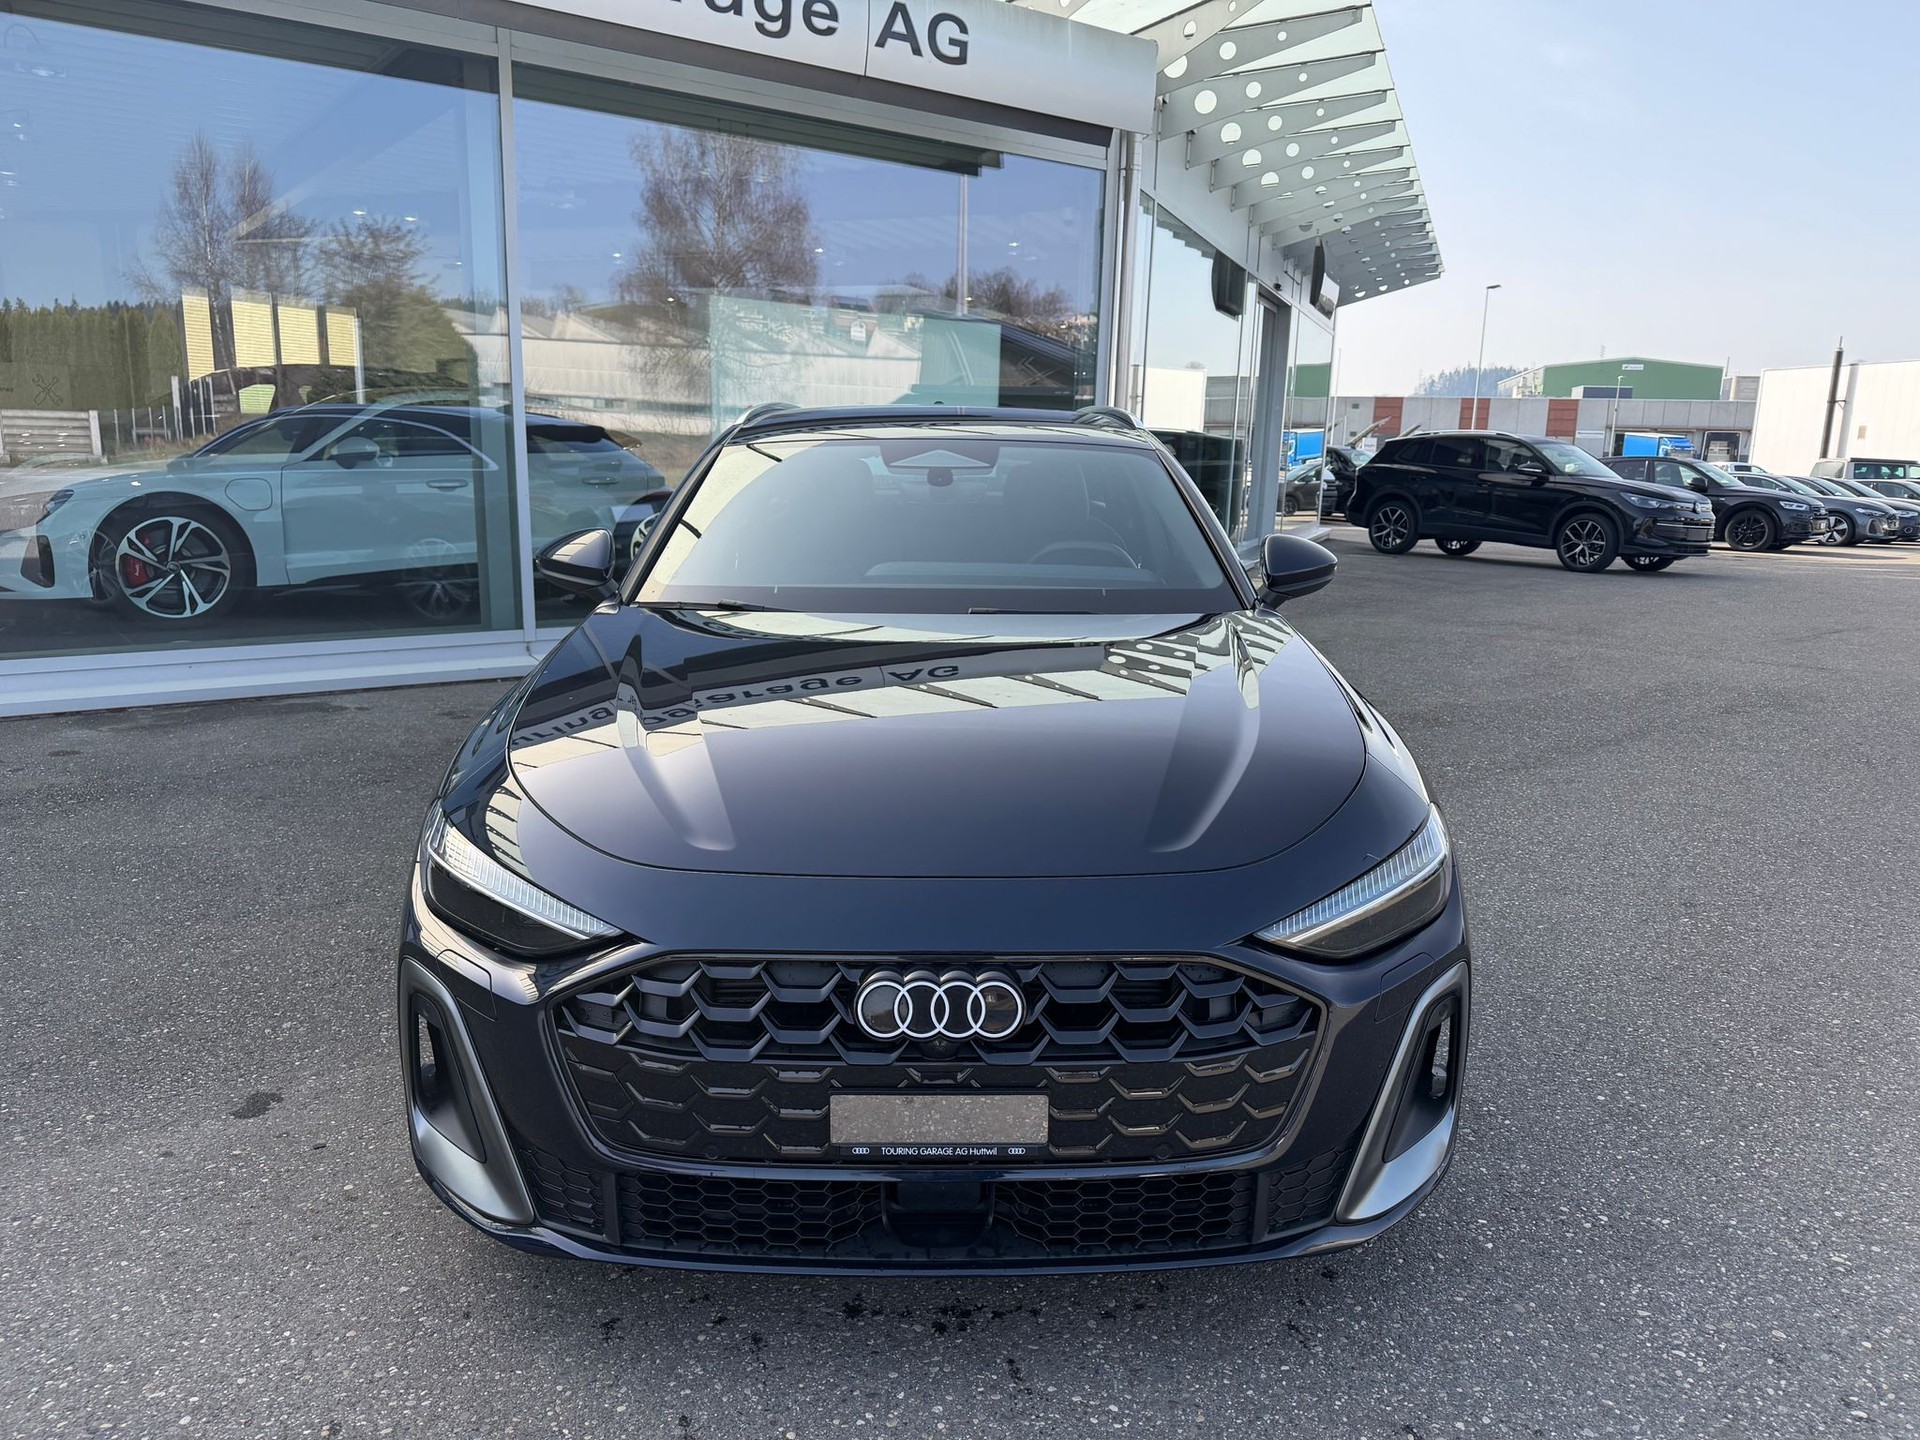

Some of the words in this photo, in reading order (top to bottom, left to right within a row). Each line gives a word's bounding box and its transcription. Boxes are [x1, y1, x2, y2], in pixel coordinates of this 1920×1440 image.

[875, 1, 969, 65] AG
[881, 1147, 918, 1155] TOURING
[919, 1147, 953, 1155] GARAGE
[955, 1147, 968, 1155] AG
[970, 1147, 998, 1155] Huttwil
